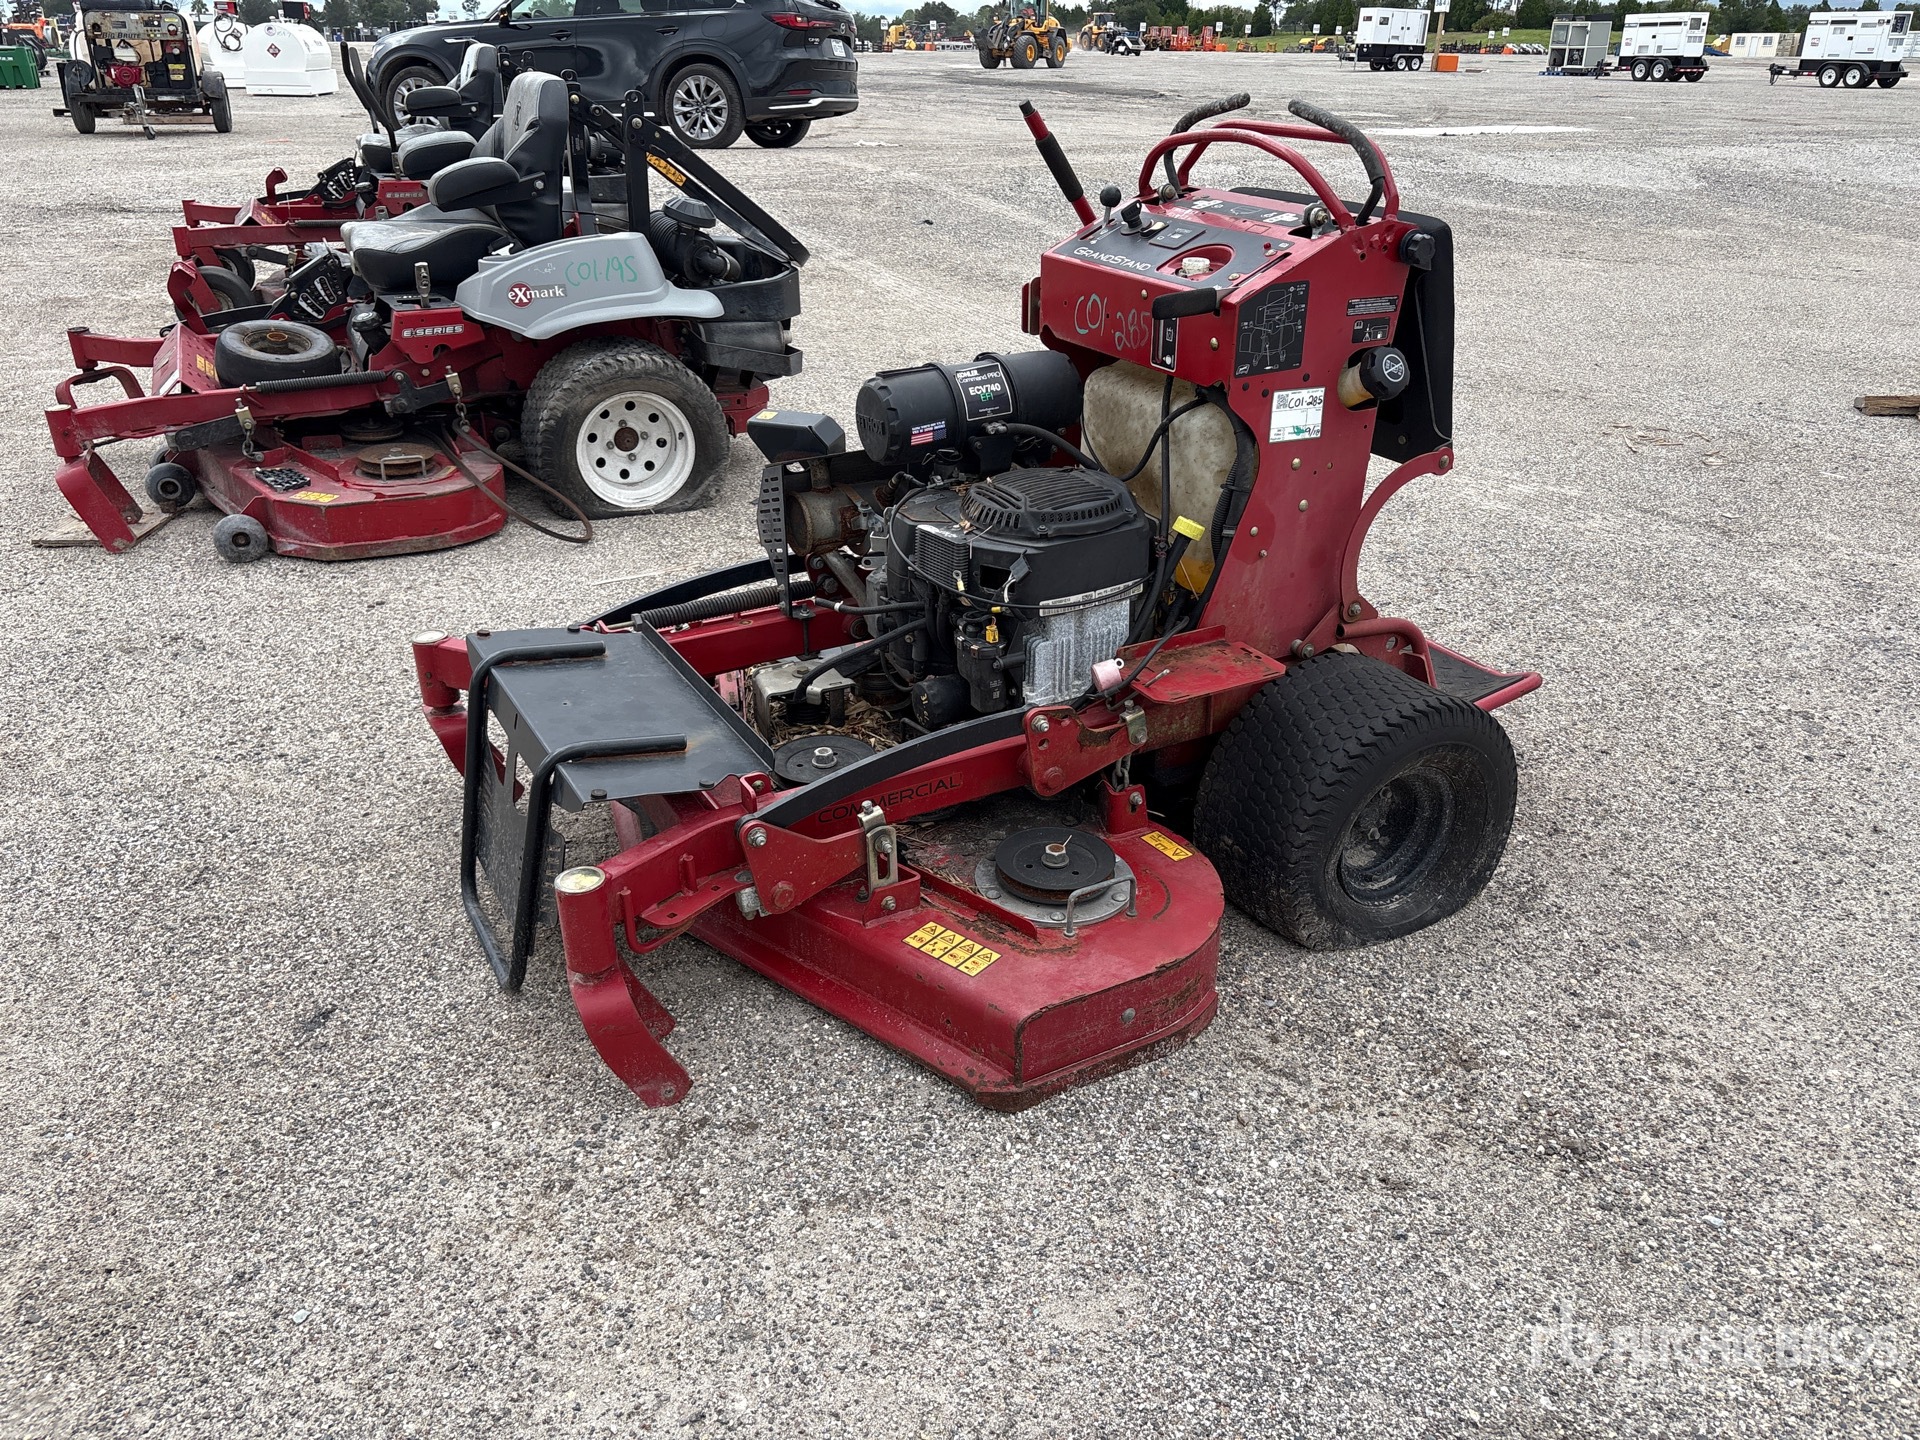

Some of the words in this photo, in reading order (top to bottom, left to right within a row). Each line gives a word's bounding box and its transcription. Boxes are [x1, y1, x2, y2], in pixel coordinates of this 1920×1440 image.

[959, 374, 988, 384] Command
[986, 371, 1001, 379] PRO
[969, 382, 1001, 396] ECV740
[980, 392, 994, 402] EFI
[817, 776, 962, 824] COMMERCIAL
